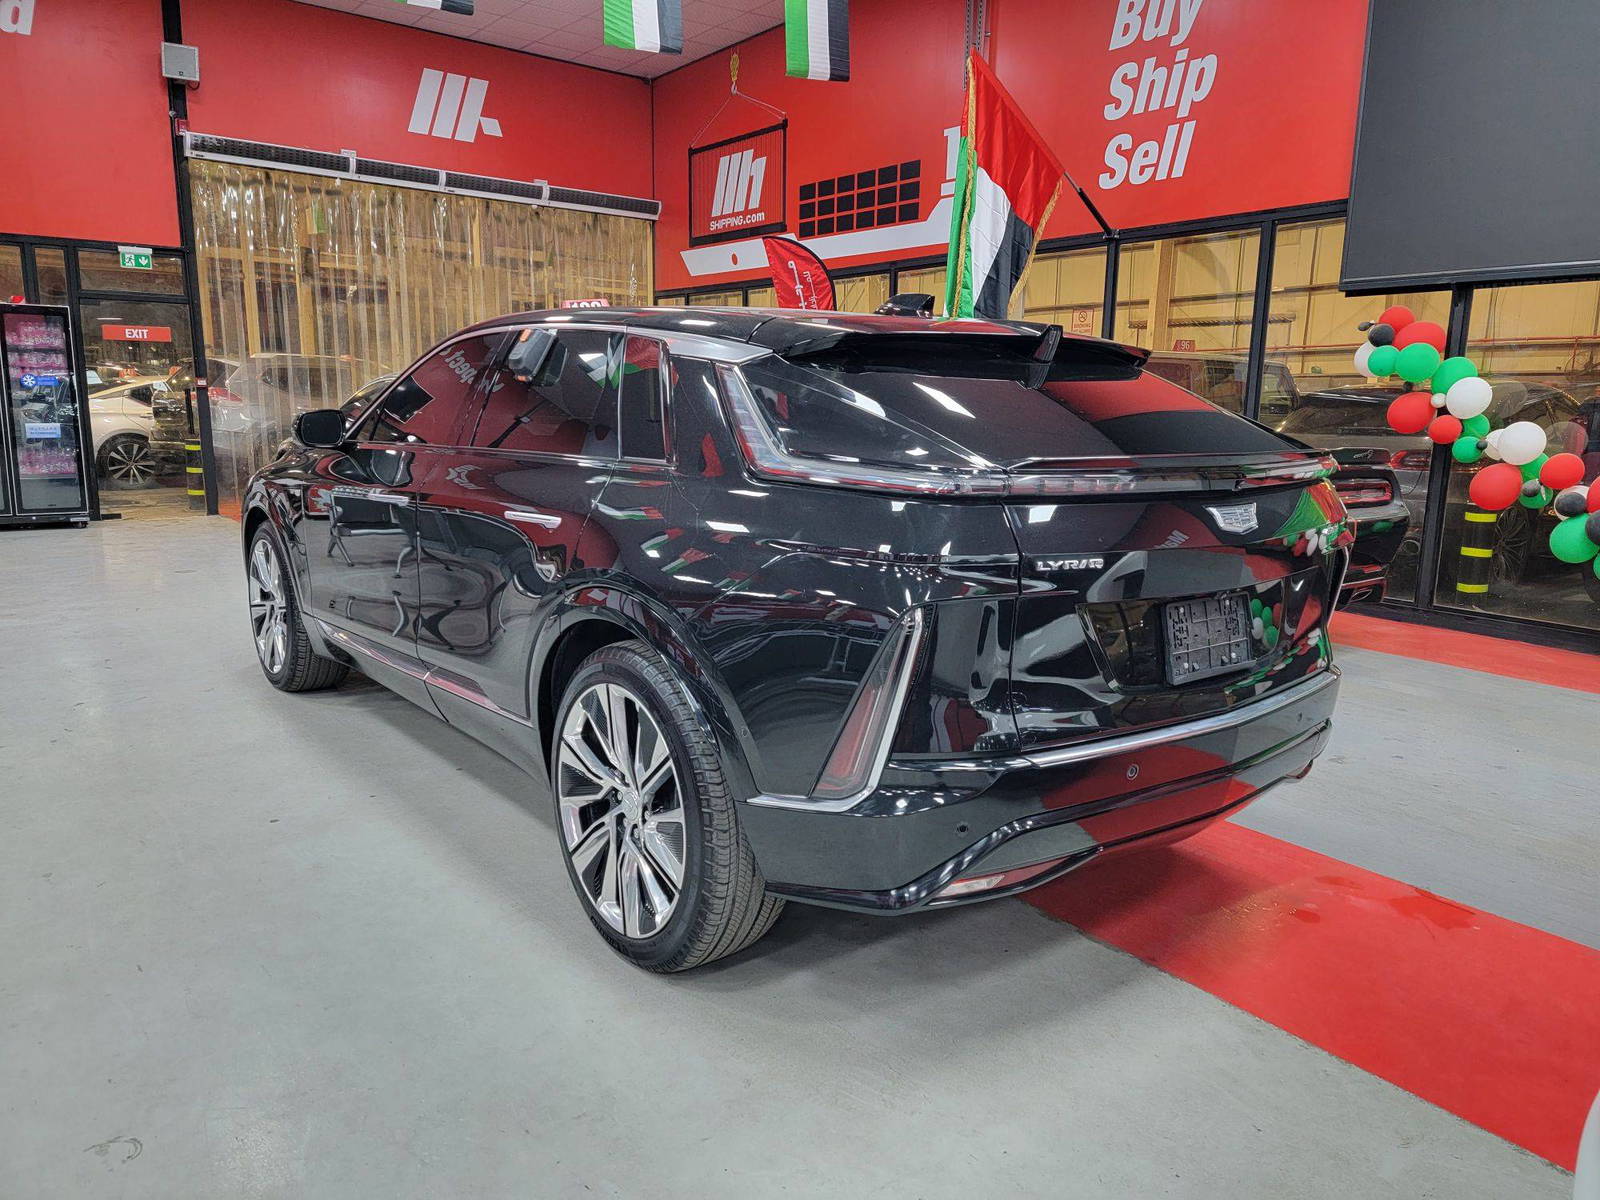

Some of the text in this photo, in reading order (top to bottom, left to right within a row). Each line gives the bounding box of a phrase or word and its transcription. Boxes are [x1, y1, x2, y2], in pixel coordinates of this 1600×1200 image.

[1109, 0, 1203, 50] Buy
[1104, 48, 1218, 120] Ship
[1099, 120, 1196, 189] Sell
[710, 212, 765, 231] SHIPPING.com
[125, 328, 148, 339] EXIT
[1181, 340, 1190, 350] 96
